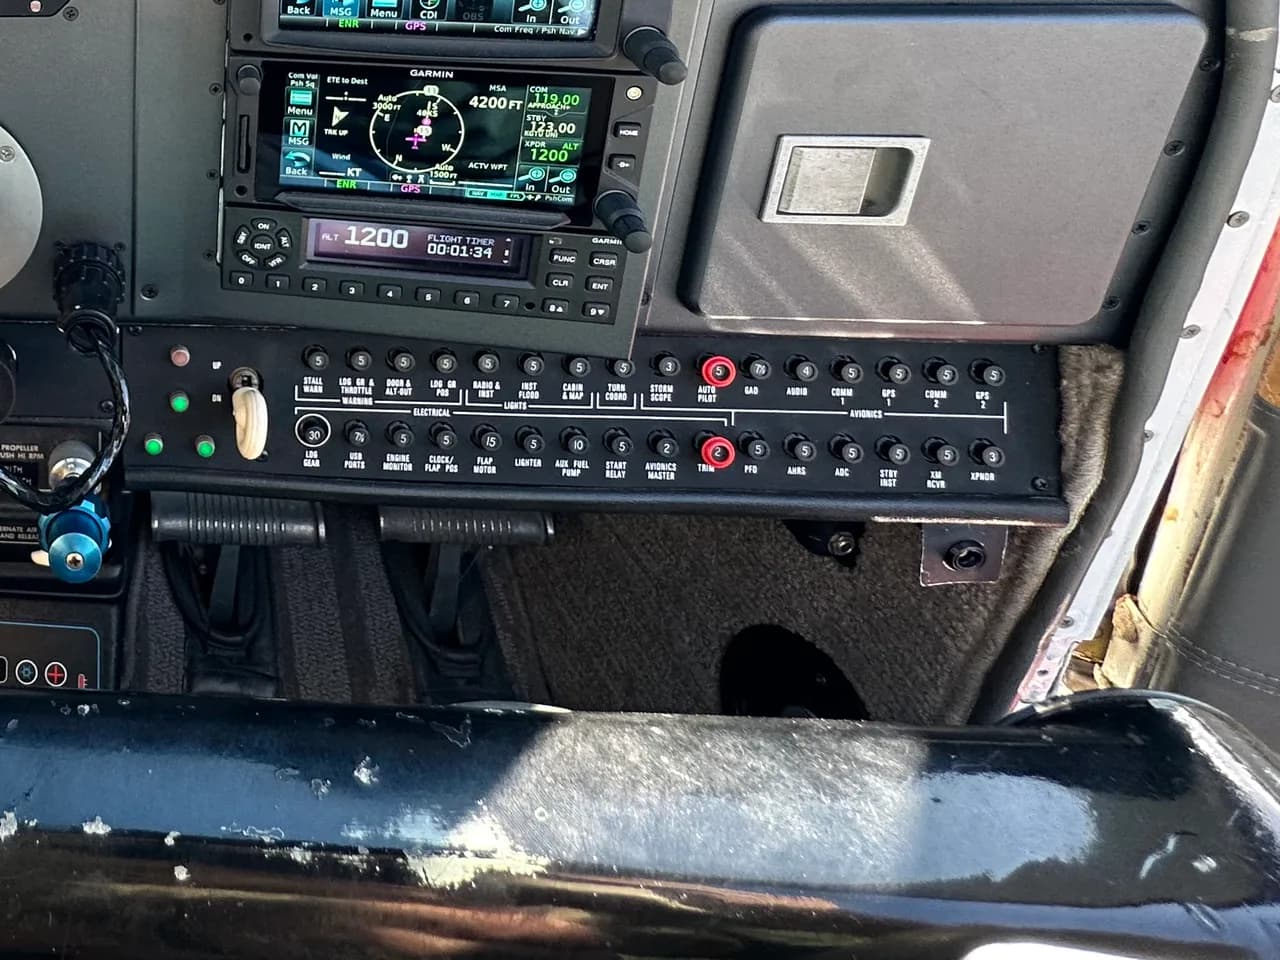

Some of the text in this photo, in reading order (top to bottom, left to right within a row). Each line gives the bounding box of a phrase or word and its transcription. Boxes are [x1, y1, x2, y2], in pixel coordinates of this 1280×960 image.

[286, 5, 311, 15] Back
[329, 7, 352, 16] MSG
[370, 8, 398, 18] Menu
[420, 10, 438, 19] CDI
[338, 19, 359, 28] ENR
[560, 15, 580, 25] Out
[405, 21, 426, 31] GPS
[410, 70, 453, 78] GARMIN
[469, 96, 523, 110] 4200 FT
[534, 94, 580, 105] 119.00
[287, 107, 313, 115] Menu
[531, 122, 576, 134] 123.00
[288, 137, 309, 145] MSG
[530, 149, 568, 162] 1200
[285, 167, 307, 176] Back
[336, 180, 357, 189] ENR
[344, 225, 409, 248] 1200
[427, 234, 495, 246] FLIGHT TIMER
[427, 243, 493, 259] 00:01:34
[553, 255, 576, 263] FUNC
[698, 394, 717, 403] PILOT
[504, 402, 527, 410] LIGHTS
[413, 409, 450, 417] ELECTRICAL
[850, 409, 883, 418] AVIONICS
[515, 459, 542, 467] LIGHTER
[606, 470, 626, 479] RELAY
[648, 472, 675, 480] MASTER
